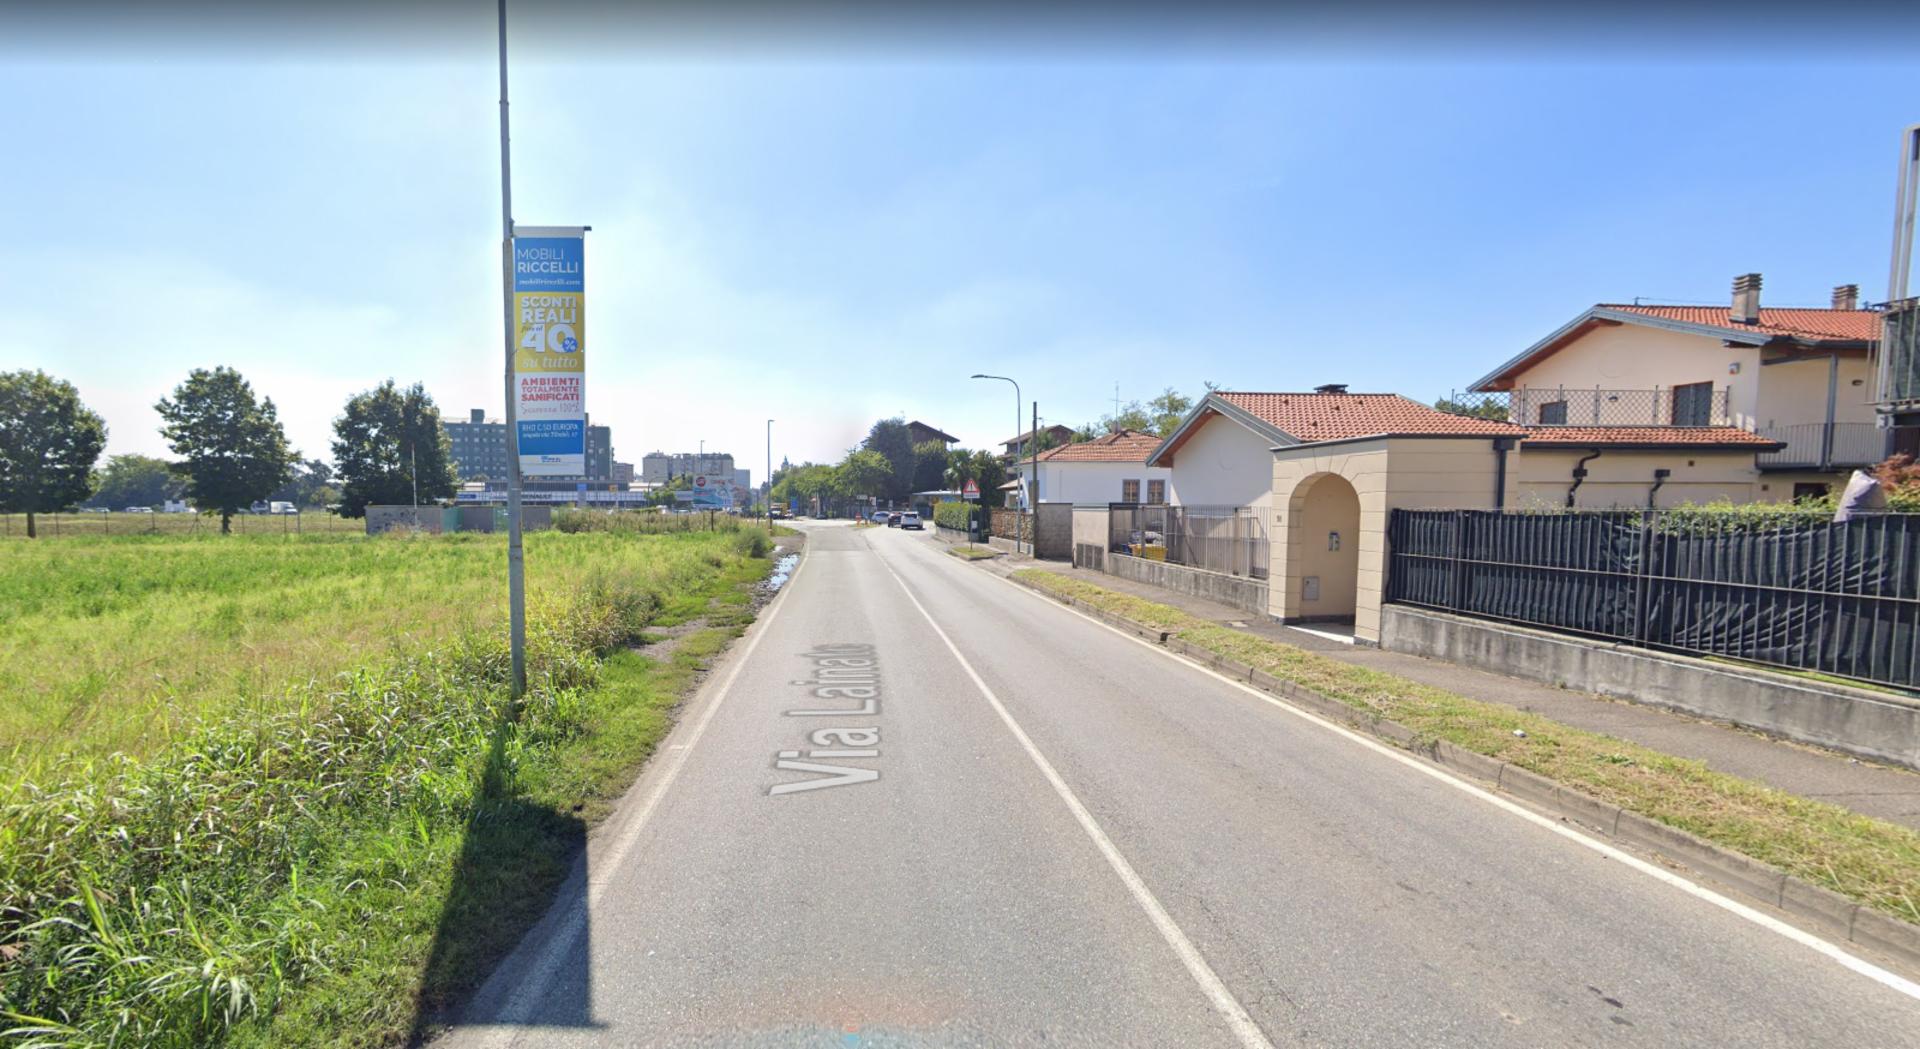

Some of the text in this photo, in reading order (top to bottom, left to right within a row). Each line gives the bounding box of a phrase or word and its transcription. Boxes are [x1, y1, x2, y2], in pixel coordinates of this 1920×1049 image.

[518, 248, 564, 260] MOBILI
[518, 261, 578, 273] RICCELLI
[521, 296, 577, 308] SCONTI
[521, 308, 577, 324] REALI
[542, 356, 577, 368] tutto
[521, 377, 579, 386] AMBIENTI
[521, 393, 579, 401] SANIFICATI
